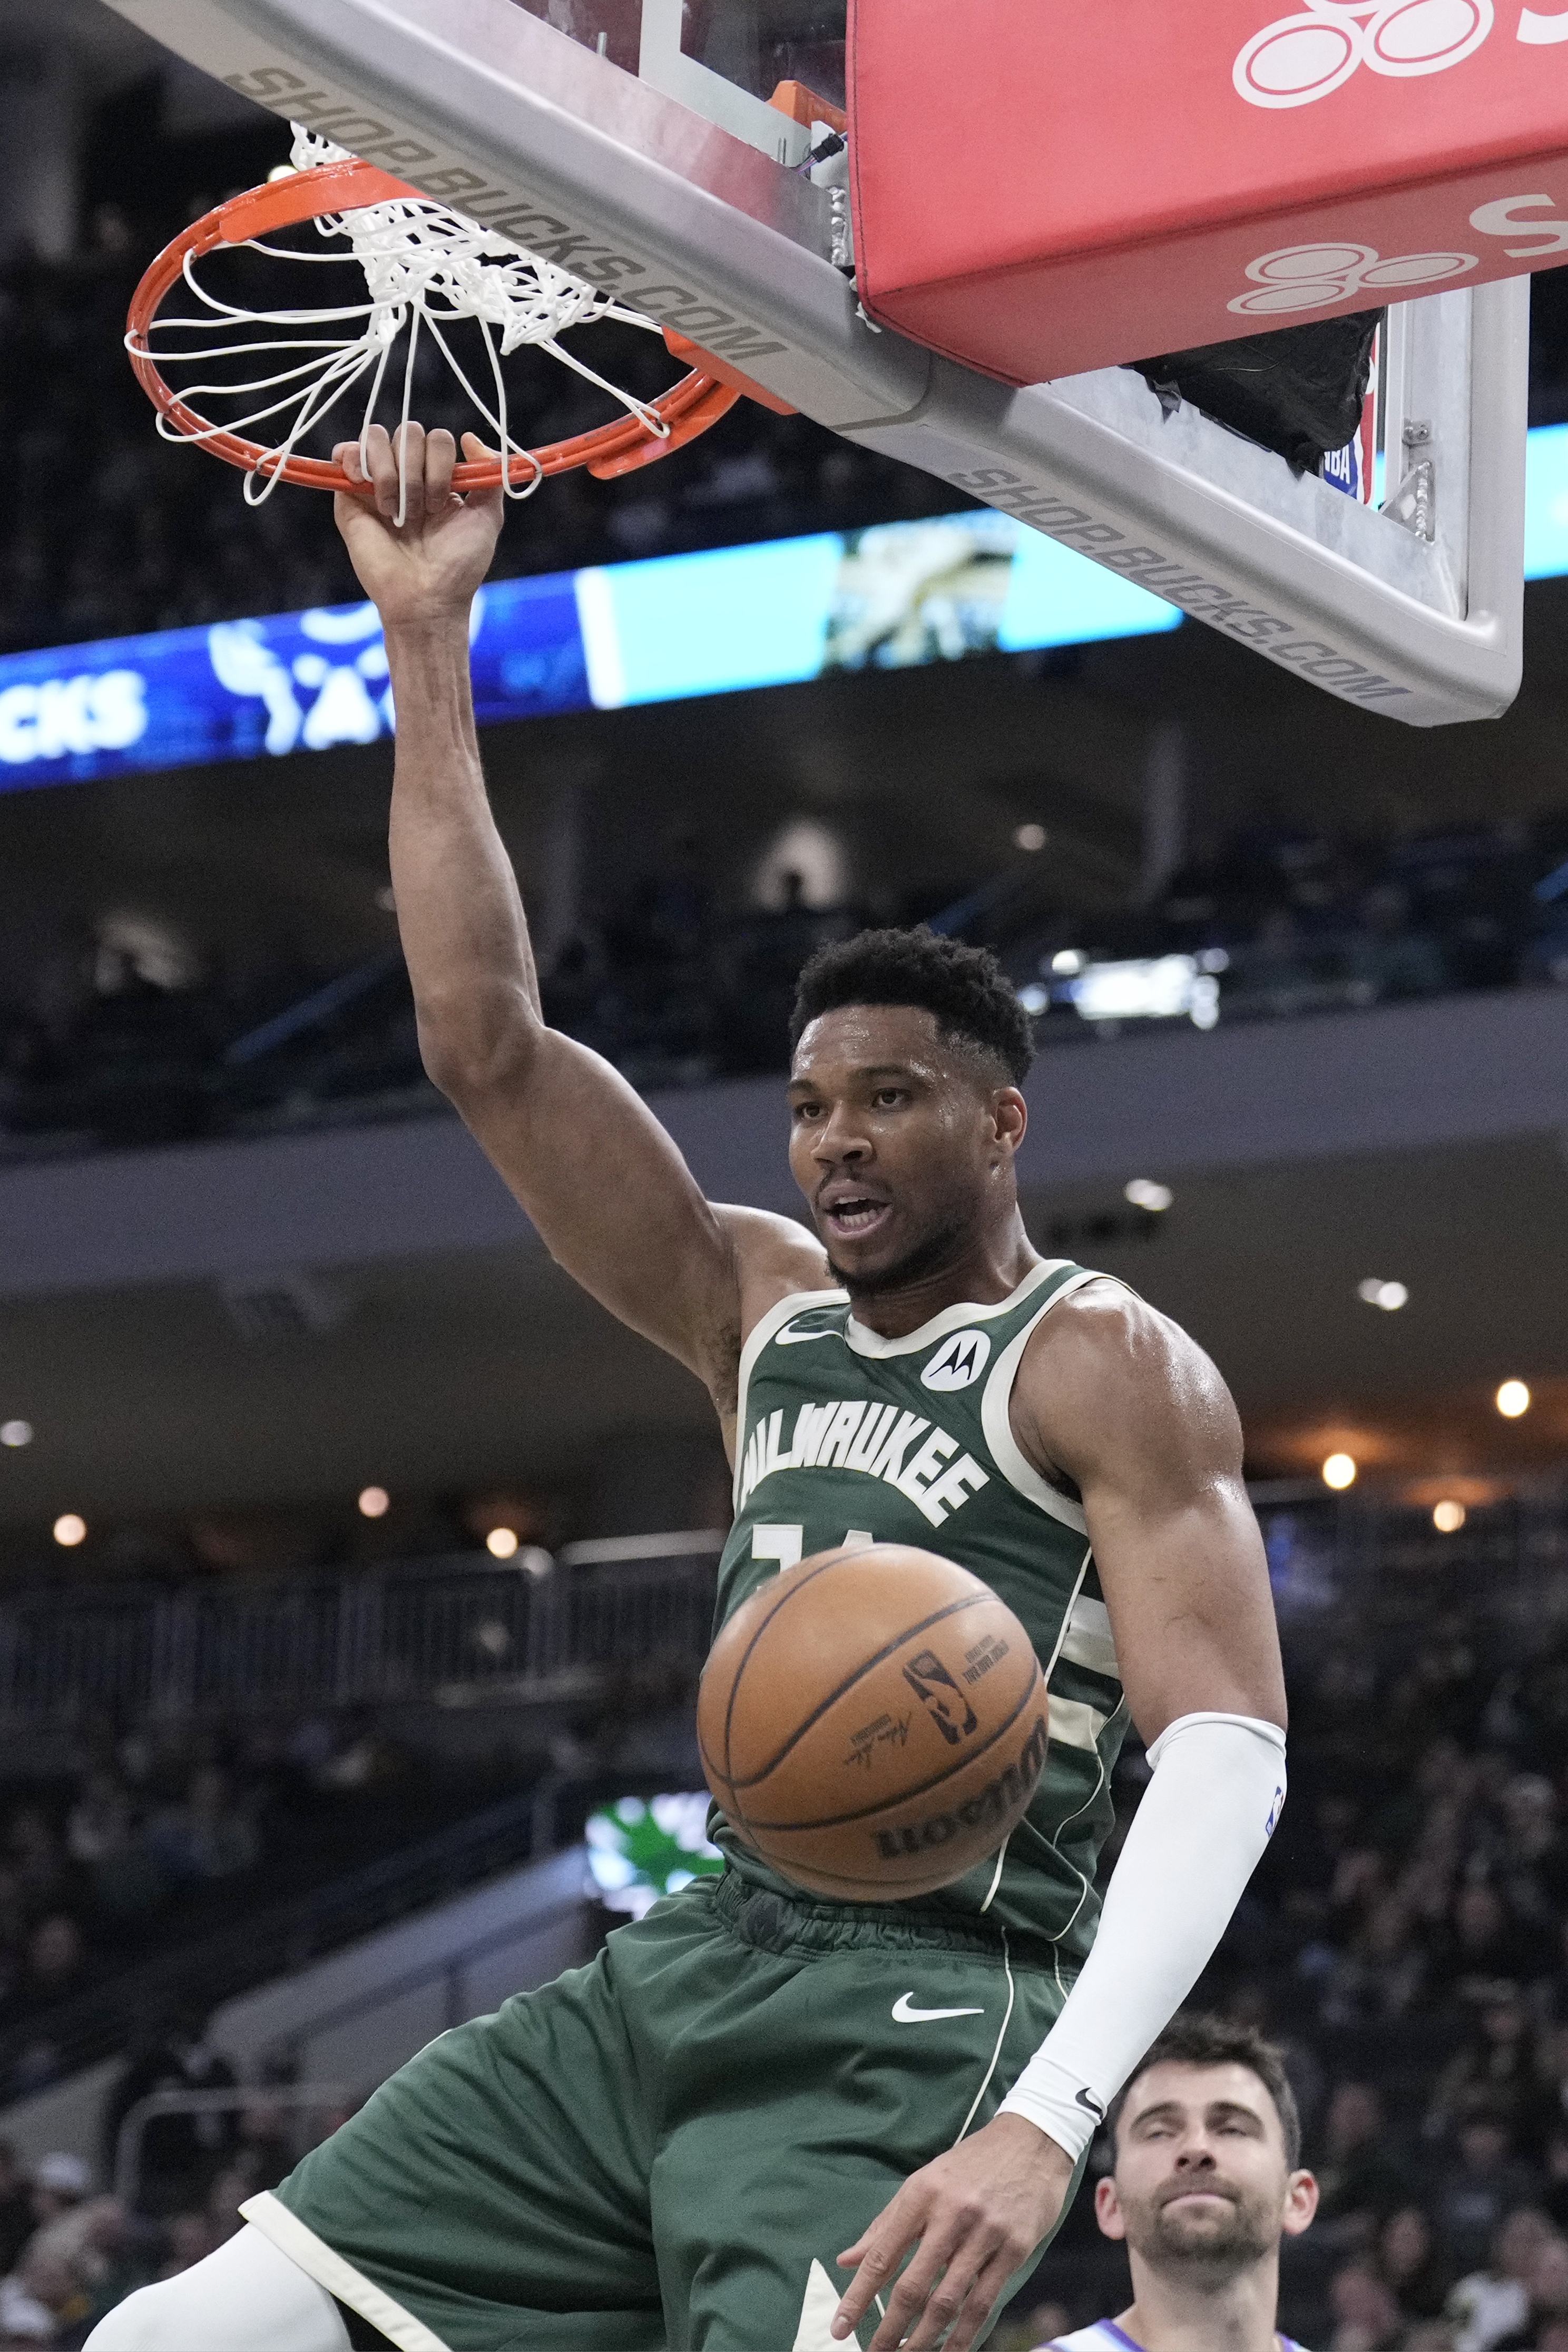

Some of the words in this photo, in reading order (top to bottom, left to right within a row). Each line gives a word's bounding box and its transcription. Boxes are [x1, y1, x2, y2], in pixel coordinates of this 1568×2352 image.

[221, 67, 788, 361] SHOP.BUCKS.COM
[949, 467, 1413, 700] SHOP.BUCKS.COM
[741, 1400, 990, 1528] MILWAUKEE
